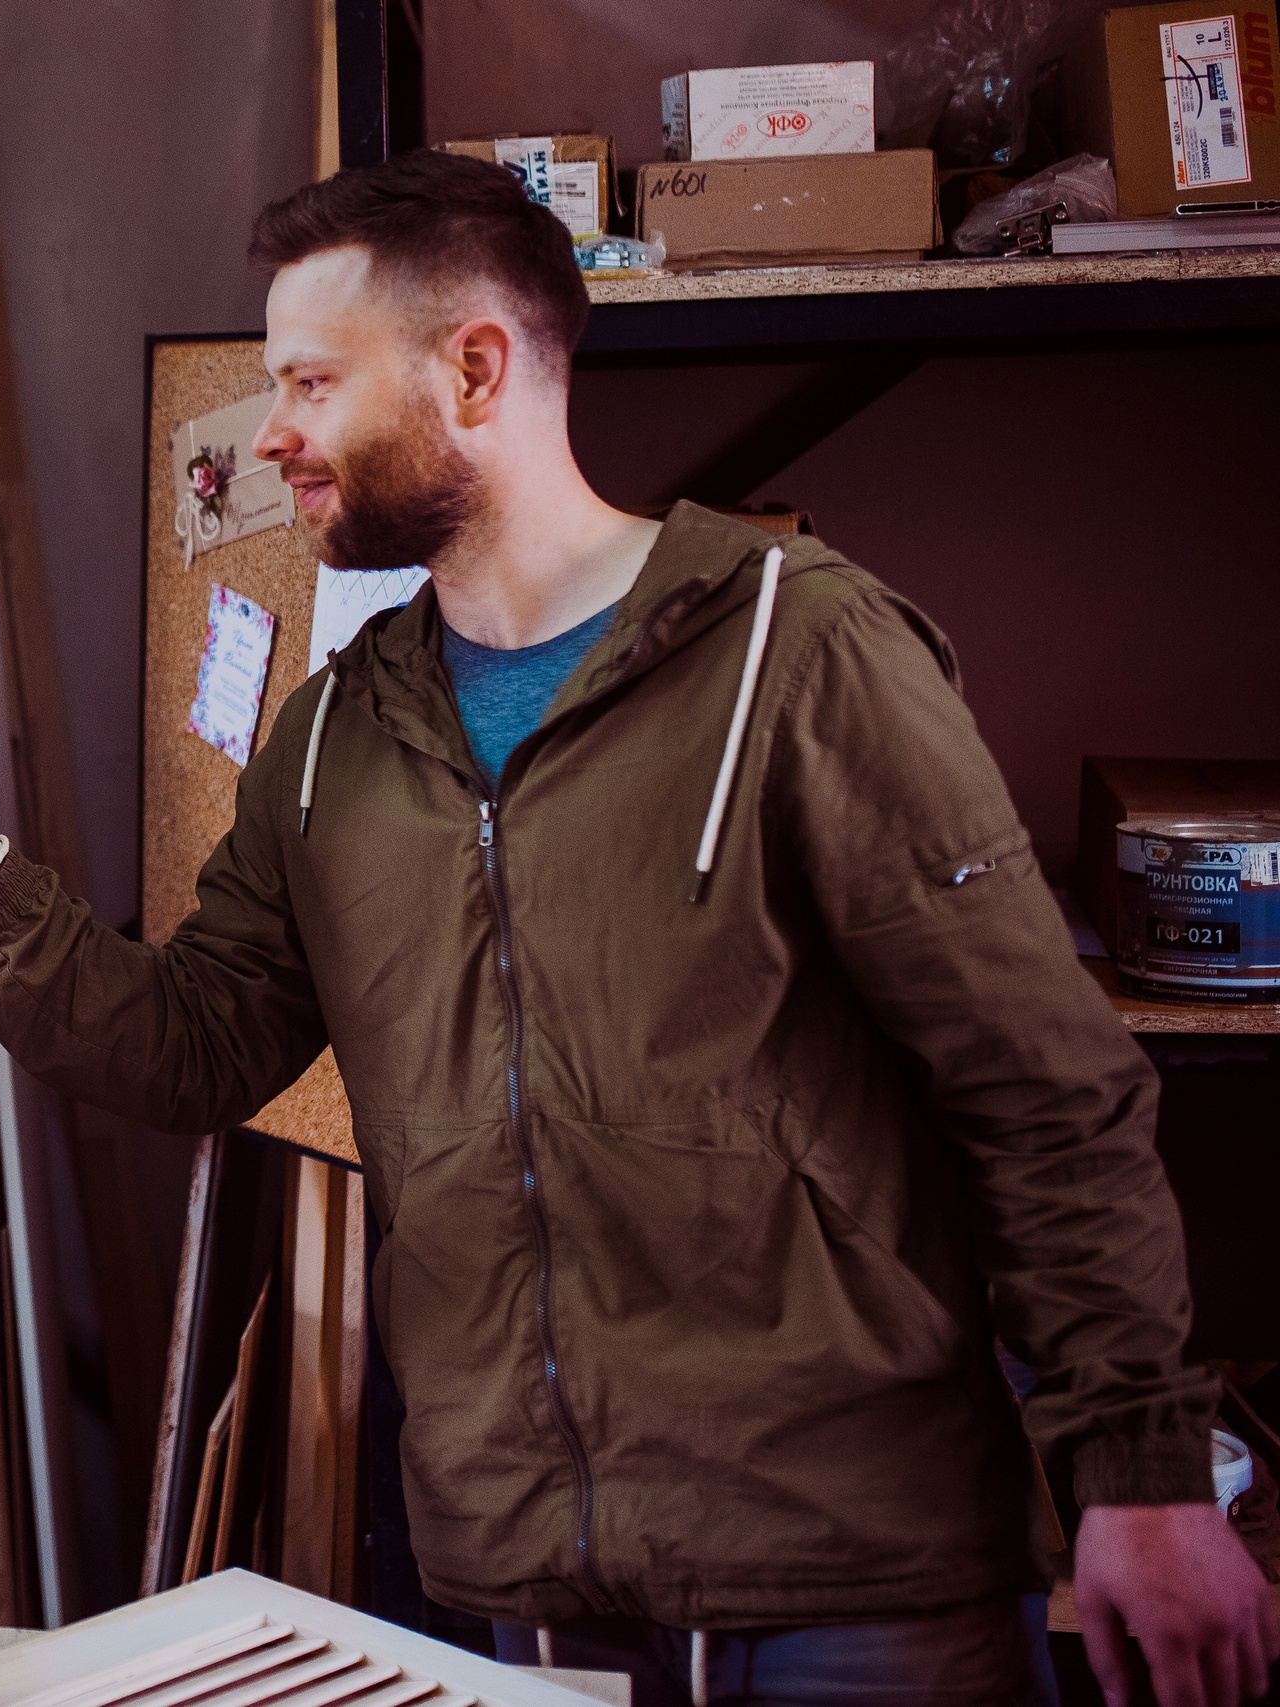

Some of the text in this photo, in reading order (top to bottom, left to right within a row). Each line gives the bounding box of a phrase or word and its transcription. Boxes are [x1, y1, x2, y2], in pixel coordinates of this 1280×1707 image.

[1196, 33, 1205, 45] 10
[1208, 32, 1222, 43] L
[1242, 11, 1276, 115] blum
[1173, 121, 1182, 146] 450.124
[1200, 138, 1211, 179] 320K5002C
[1177, 161, 1186, 184] blum
[1147, 872, 1239, 892] ГРУНТОВКА
[1156, 924, 1223, 944] ГФ-021
